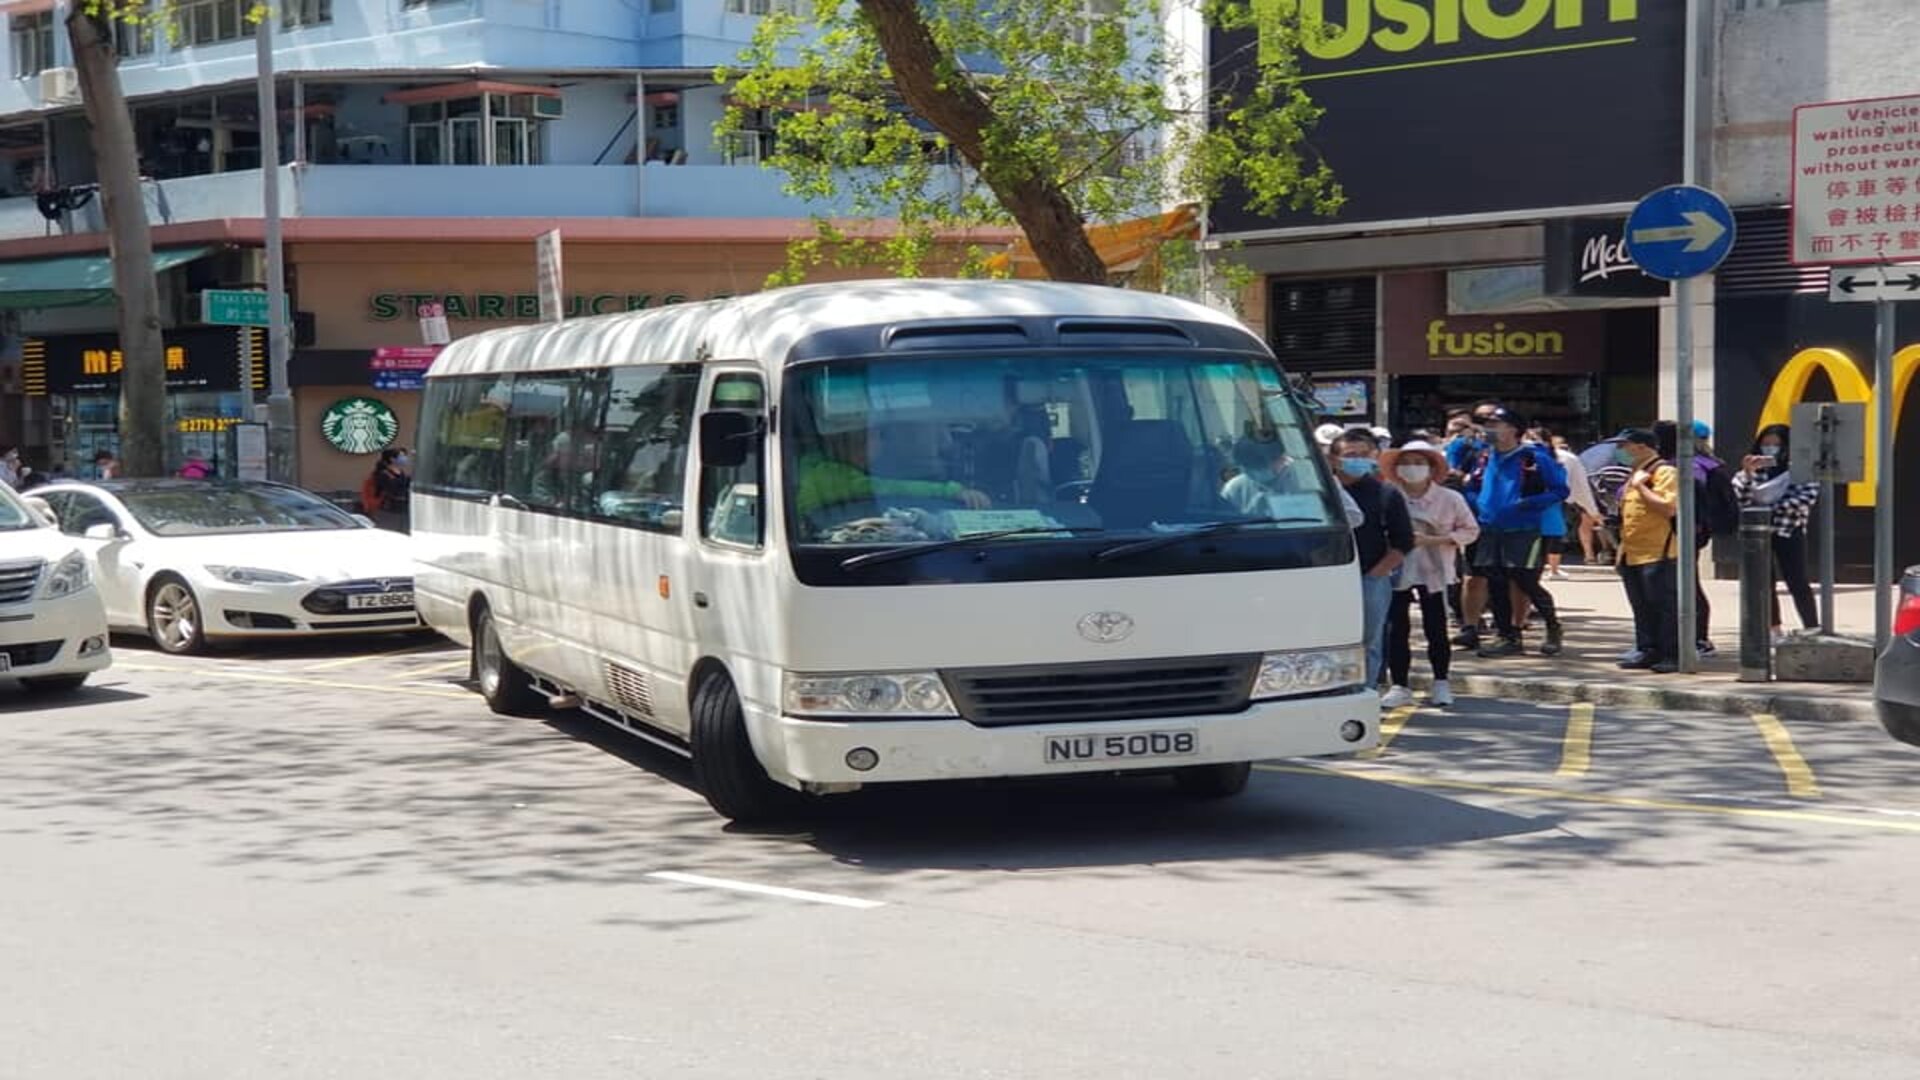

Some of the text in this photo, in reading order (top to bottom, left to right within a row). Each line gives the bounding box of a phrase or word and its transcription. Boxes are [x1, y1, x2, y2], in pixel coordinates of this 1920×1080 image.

[1813, 125, 1886, 141] waiting
[1803, 159, 1878, 175] without
[1426, 320, 1563, 355] fusion
[1050, 738, 1094, 760] NU
